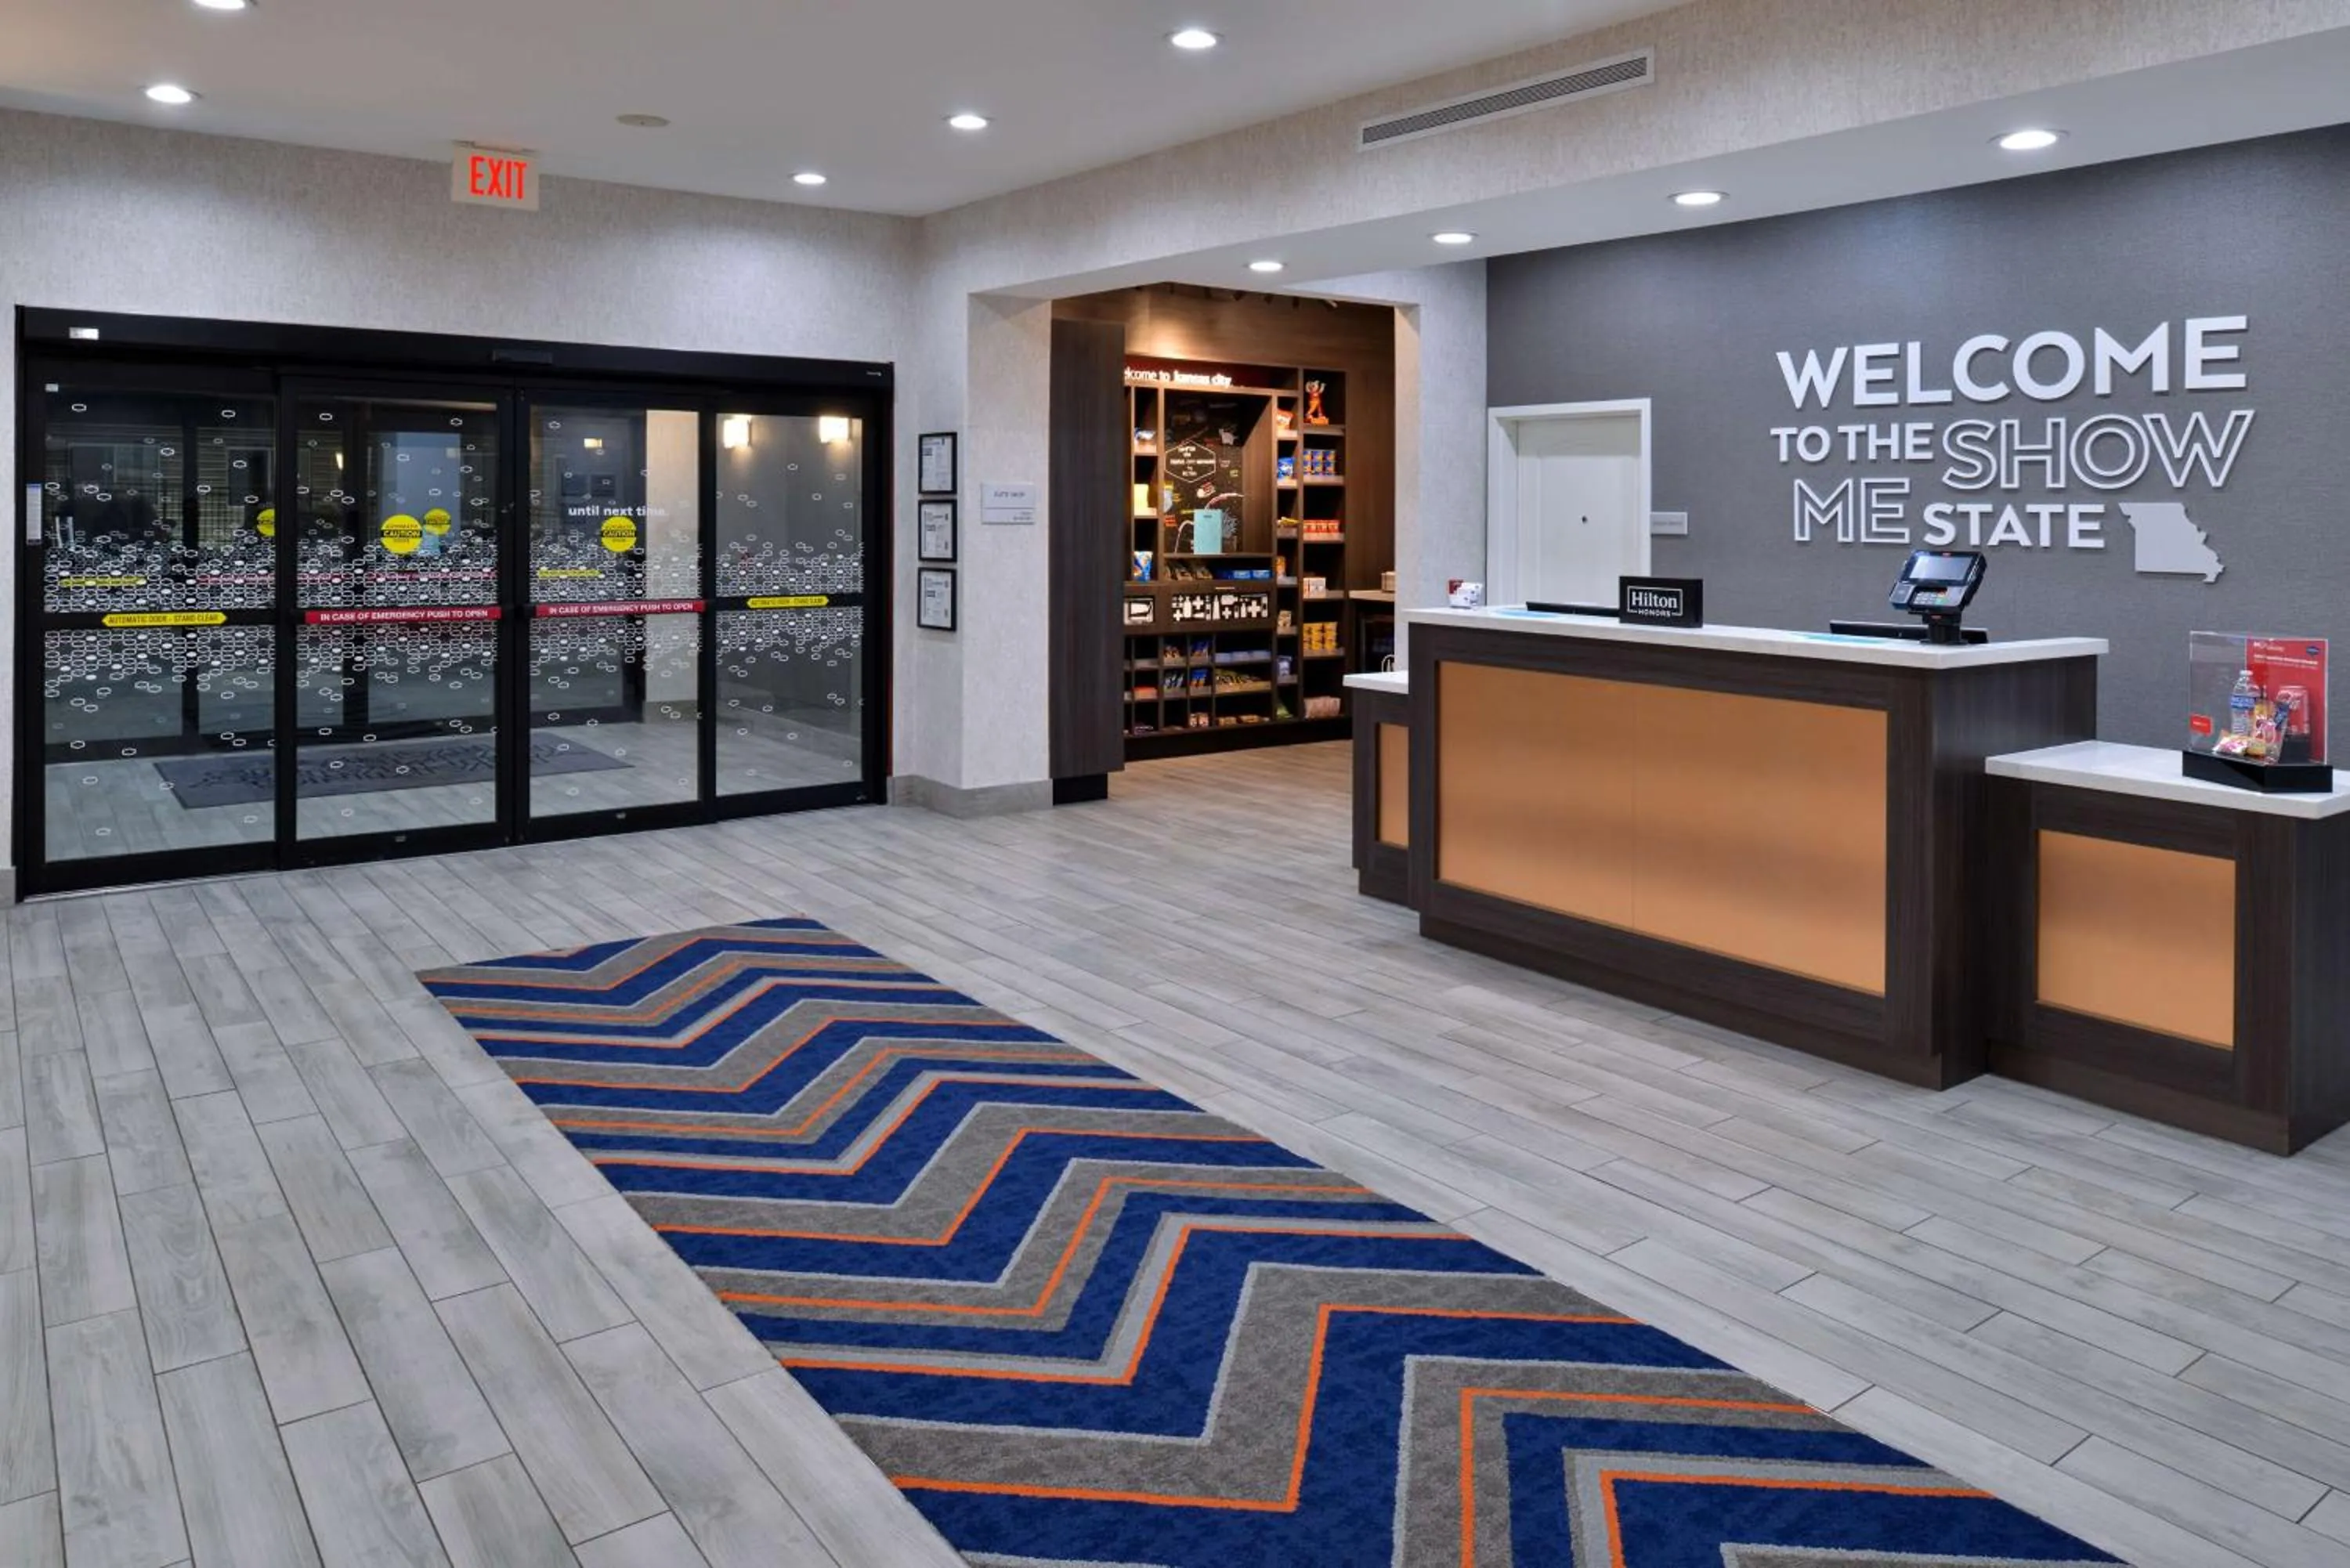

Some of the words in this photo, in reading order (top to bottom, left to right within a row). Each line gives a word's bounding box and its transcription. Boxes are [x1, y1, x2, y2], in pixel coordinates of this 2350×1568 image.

[470, 155, 527, 200] EXIT
[1776, 315, 2247, 410] WELCOME
[1159, 370, 1170, 381] to
[1770, 426, 1831, 463] TO
[1837, 421, 1935, 461] THE
[1942, 409, 2255, 490] SHOW
[568, 505, 600, 516] until
[603, 506, 634, 516] next
[1794, 477, 1911, 544] ME
[1922, 502, 2106, 548] STATE
[1632, 591, 1677, 609] Hilton
[331, 612, 356, 621] CASE
[357, 612, 371, 620] OF
[371, 611, 425, 620] EMERGENCY
[427, 610, 450, 619] PUSH
[451, 609, 464, 618] TO
[465, 609, 488, 618] OPEN
[559, 606, 579, 615] CASE
[591, 604, 638, 613] EMERGENCY
[640, 603, 660, 612] PUSH
[673, 602, 693, 611] OPEN
[1638, 609, 1671, 617] HONORS
[197, 612, 219, 621] CLEAR
